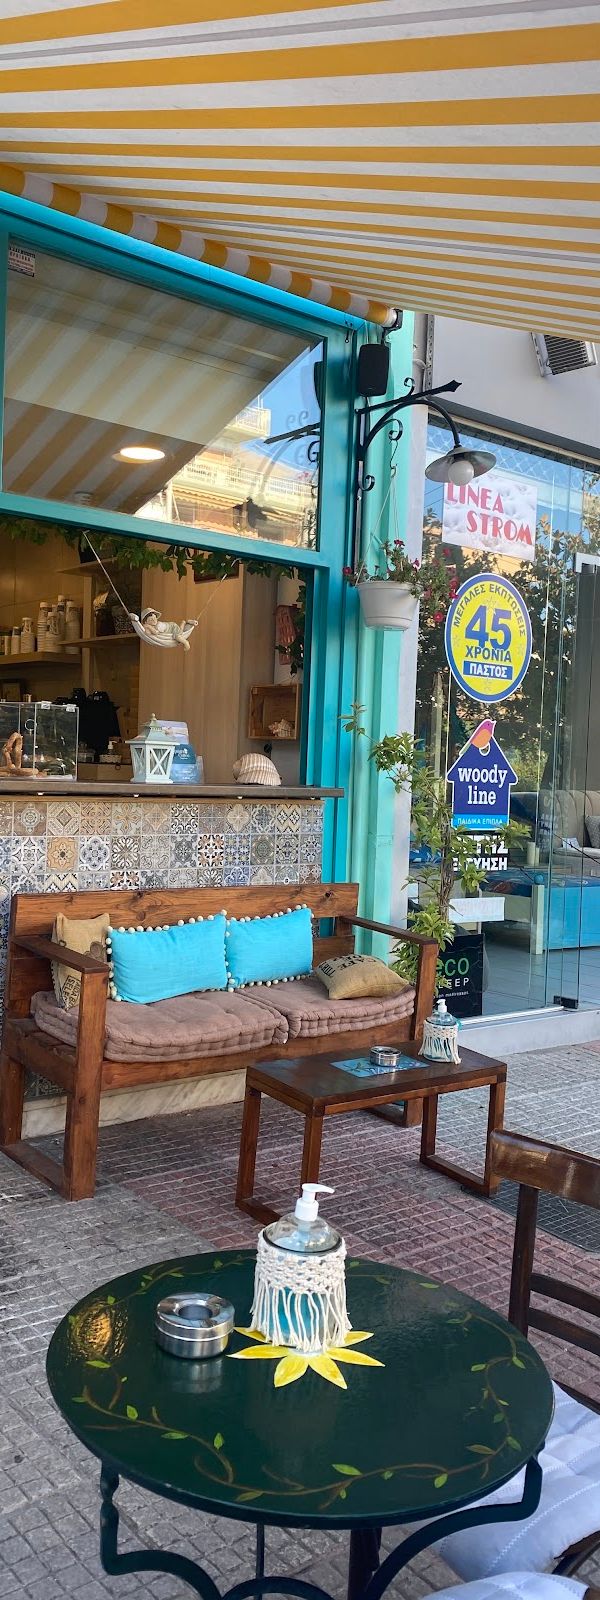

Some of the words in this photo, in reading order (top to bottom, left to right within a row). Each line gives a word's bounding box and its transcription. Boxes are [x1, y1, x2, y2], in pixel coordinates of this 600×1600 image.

[447, 481, 504, 514] LINEA
[466, 510, 533, 545] STROM
[453, 583, 486, 628] ΜΕΓΑΛΕΣ
[489, 583, 526, 637] ΕΚΠΤΩΣΕΙΣ
[465, 604, 512, 650] 45
[465, 645, 512, 662] ΧΡΟΝΙΑ
[469, 663, 508, 678] ΠΑΣΤΟΣ
[457, 763, 508, 788] woody
[467, 785, 497, 805] line
[457, 817, 481, 825] ΠΑΙΔΙΚΑ
[453, 857, 508, 871] ΕΓΥΗΣΗ
